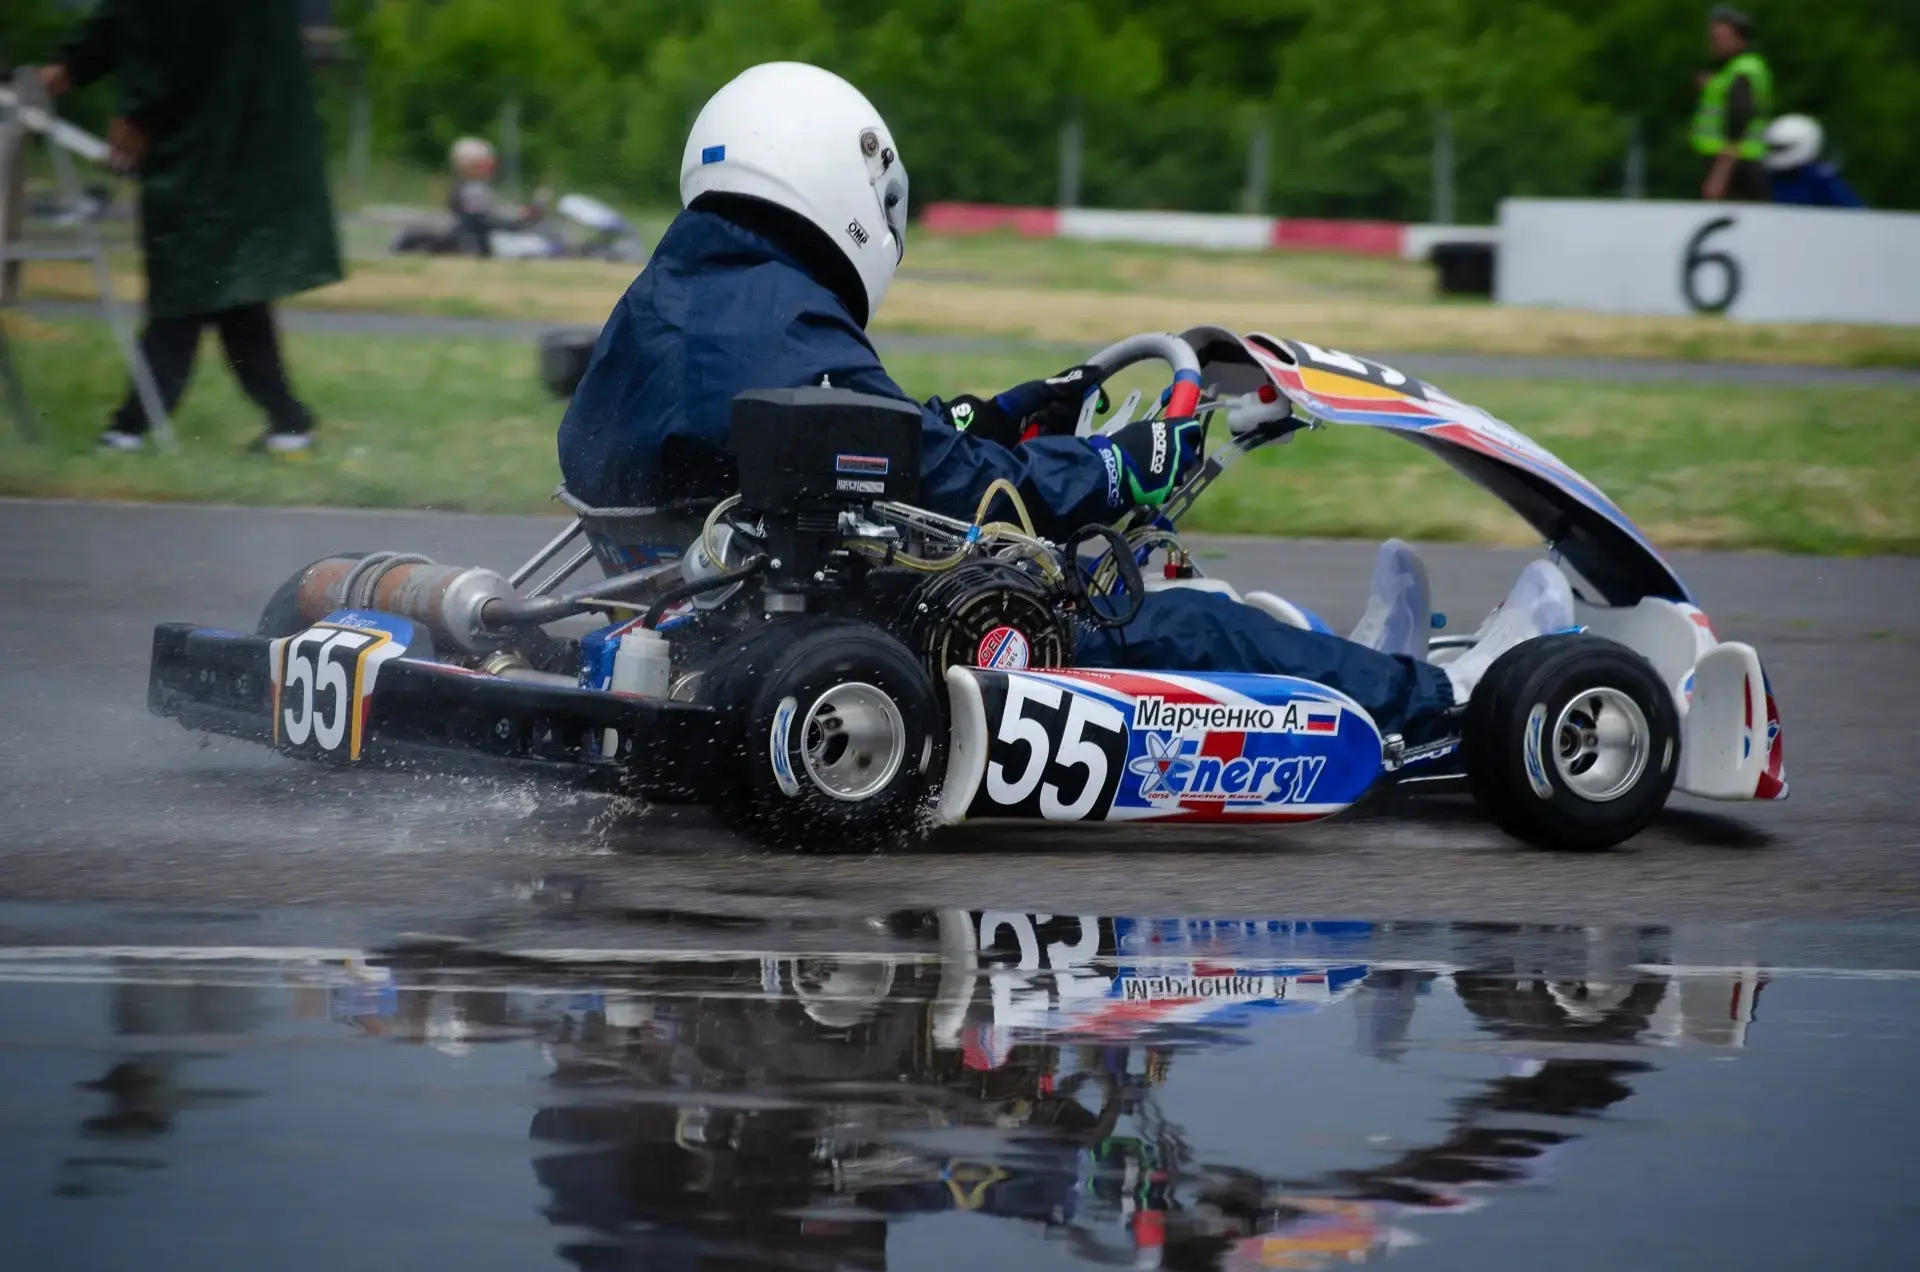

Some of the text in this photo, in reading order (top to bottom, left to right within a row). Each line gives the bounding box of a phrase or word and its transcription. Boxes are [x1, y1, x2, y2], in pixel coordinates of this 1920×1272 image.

[848, 221, 869, 245] OMP
[1682, 215, 1742, 315] 6
[1099, 448, 1119, 507] sparco
[1151, 422, 1167, 474] sparco
[284, 628, 371, 750] 55
[1136, 699, 1305, 733] Марченко А.
[987, 673, 1125, 821] 55
[1145, 738, 1326, 804] Energy
